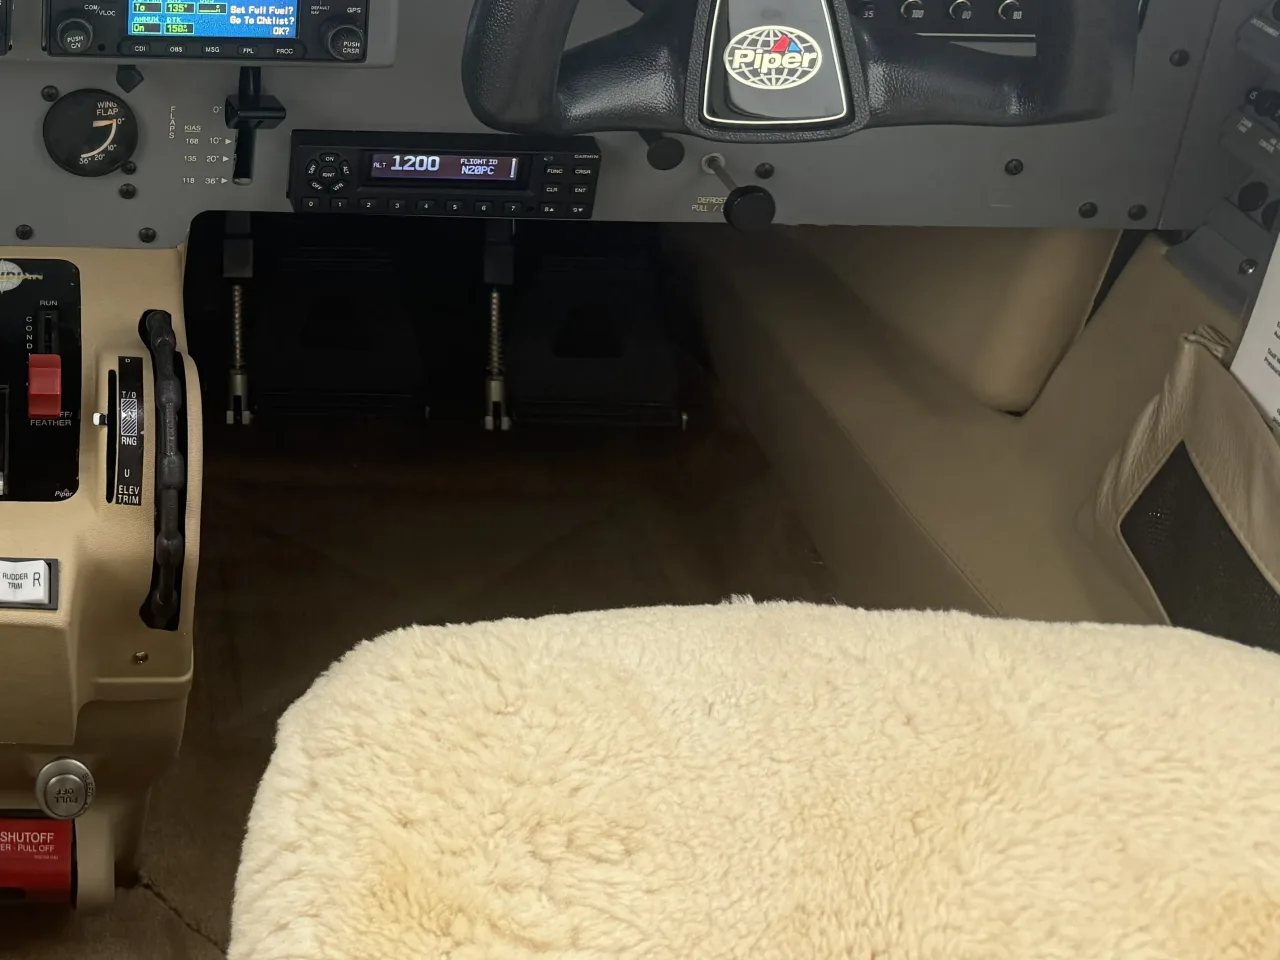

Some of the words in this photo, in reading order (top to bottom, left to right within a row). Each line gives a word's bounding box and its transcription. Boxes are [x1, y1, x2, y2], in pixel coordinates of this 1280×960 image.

[733, 47, 817, 71] Piper
[391, 155, 440, 171] 1200
[122, 437, 136, 445] RNG
[119, 486, 139, 494] ELEV
[118, 495, 139, 504] TRIM
[2, 572, 28, 581] RUDDER
[32, 572, 41, 586] R
[0, 831, 54, 843] SHUTOFF
